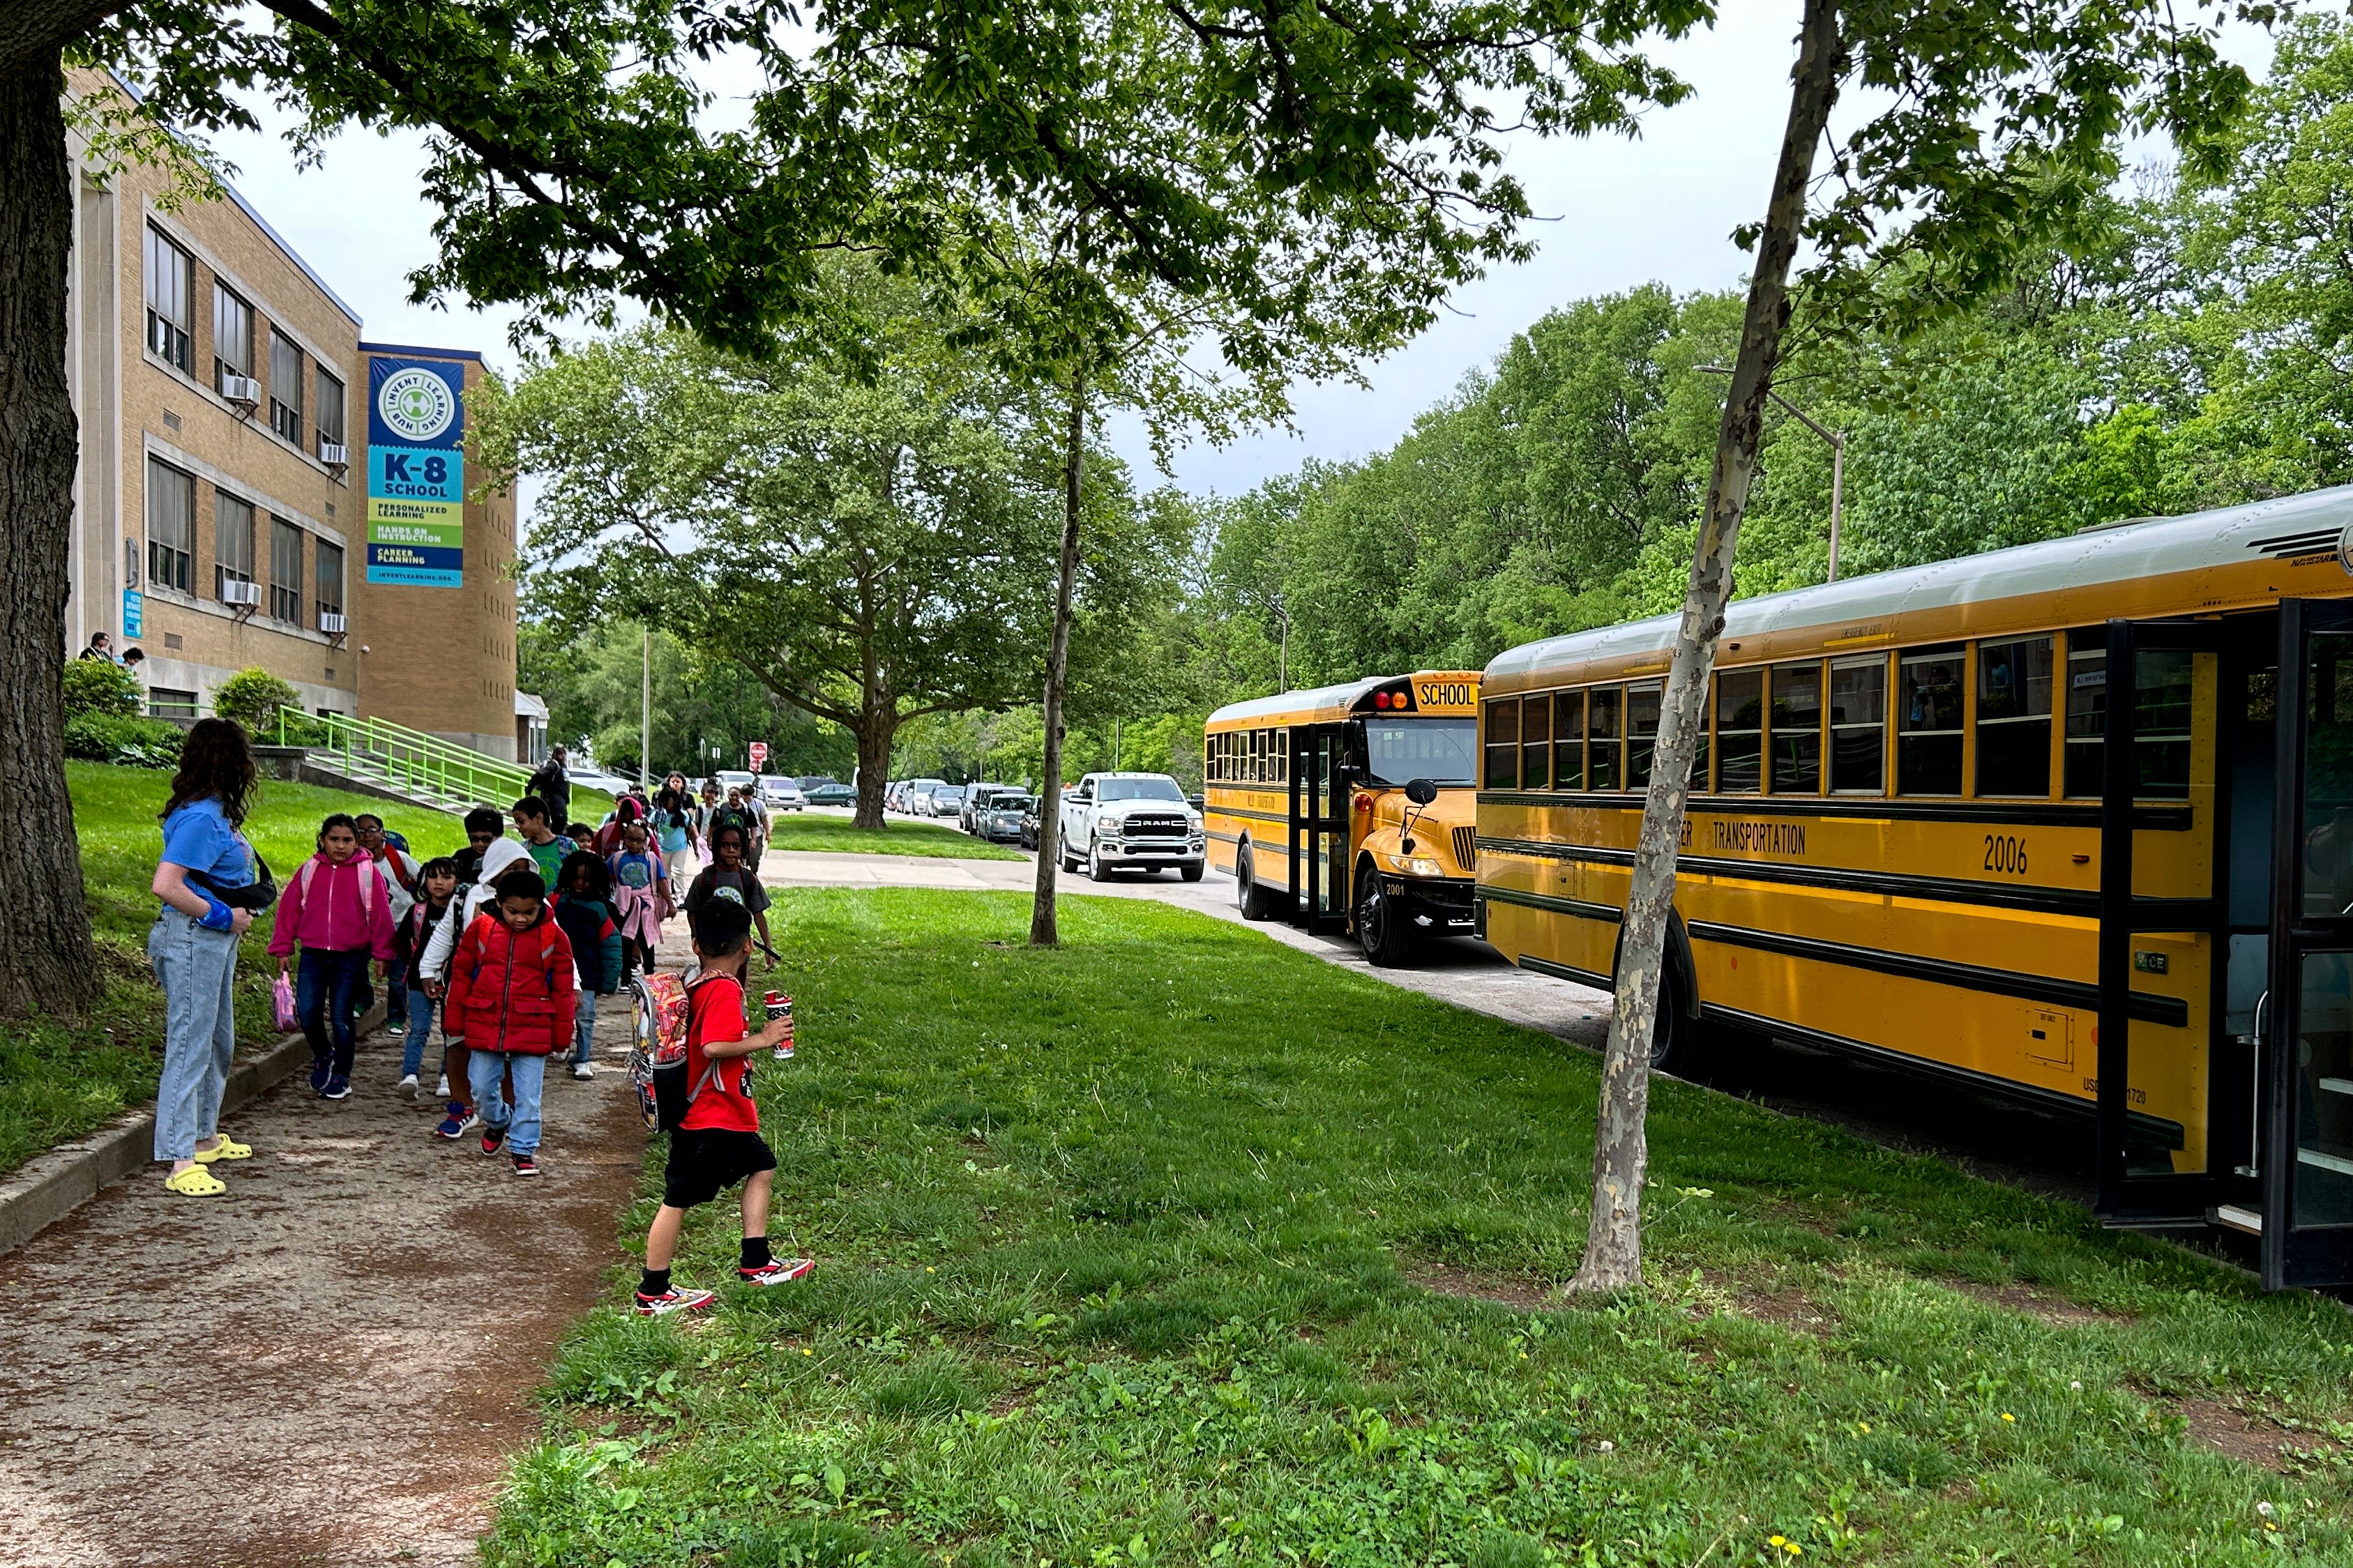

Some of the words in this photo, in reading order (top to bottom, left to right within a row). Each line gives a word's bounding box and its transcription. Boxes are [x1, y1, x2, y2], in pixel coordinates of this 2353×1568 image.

[388, 377, 418, 405] INVENT
[422, 381, 445, 430] LEARNING
[393, 413, 414, 430] HUB
[385, 453, 447, 484] K-8
[384, 483, 448, 497] SCHOOL
[378, 503, 447, 514] PERSONALIZED
[378, 510, 425, 519] LEARNING
[377, 526, 411, 534] HANDS
[377, 532, 441, 543] INSTRUCTION
[377, 548, 413, 557] CAREER
[377, 556, 425, 565] PLANNING
[1421, 684, 1474, 705] SCHOOL
[1681, 820, 1693, 847] ER
[1713, 821, 1806, 855] TRANSPORTATION
[1984, 834, 2027, 875] 2006
[1386, 883, 1405, 896] 2001
[2127, 1088, 2147, 1105] 1720
